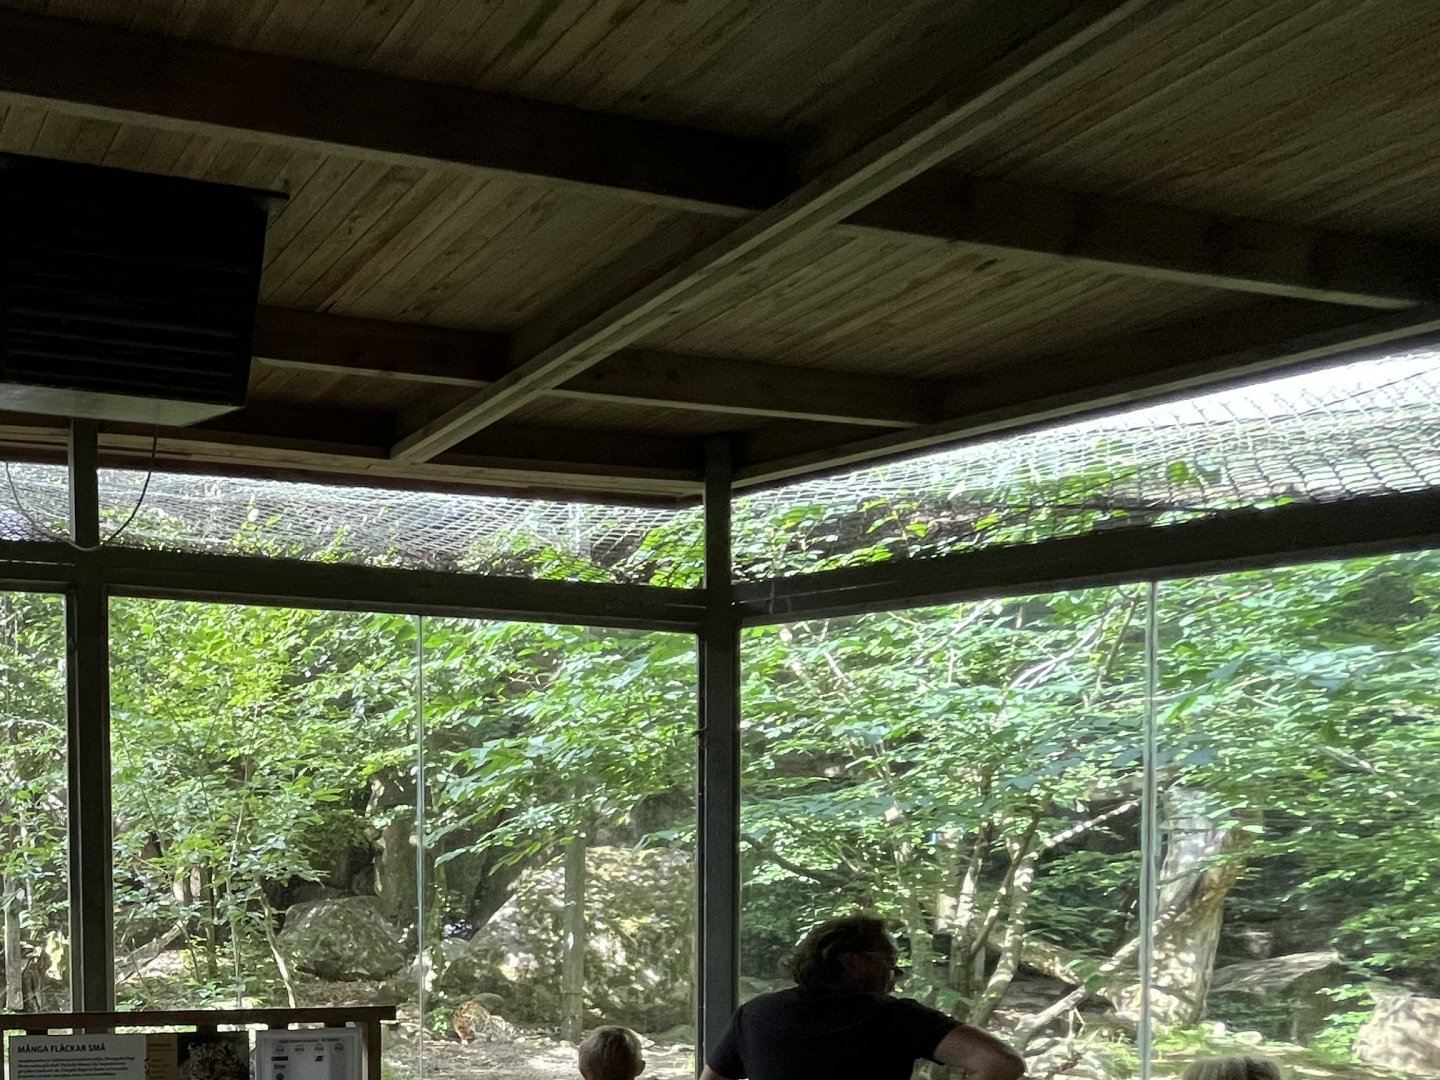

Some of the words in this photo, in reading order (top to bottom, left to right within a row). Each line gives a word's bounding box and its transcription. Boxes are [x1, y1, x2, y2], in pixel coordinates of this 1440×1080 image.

[17, 1044, 48, 1054] MÅNGA
[50, 1043, 86, 1053] FLÄCKAR
[88, 1042, 105, 1052] SMÅ
